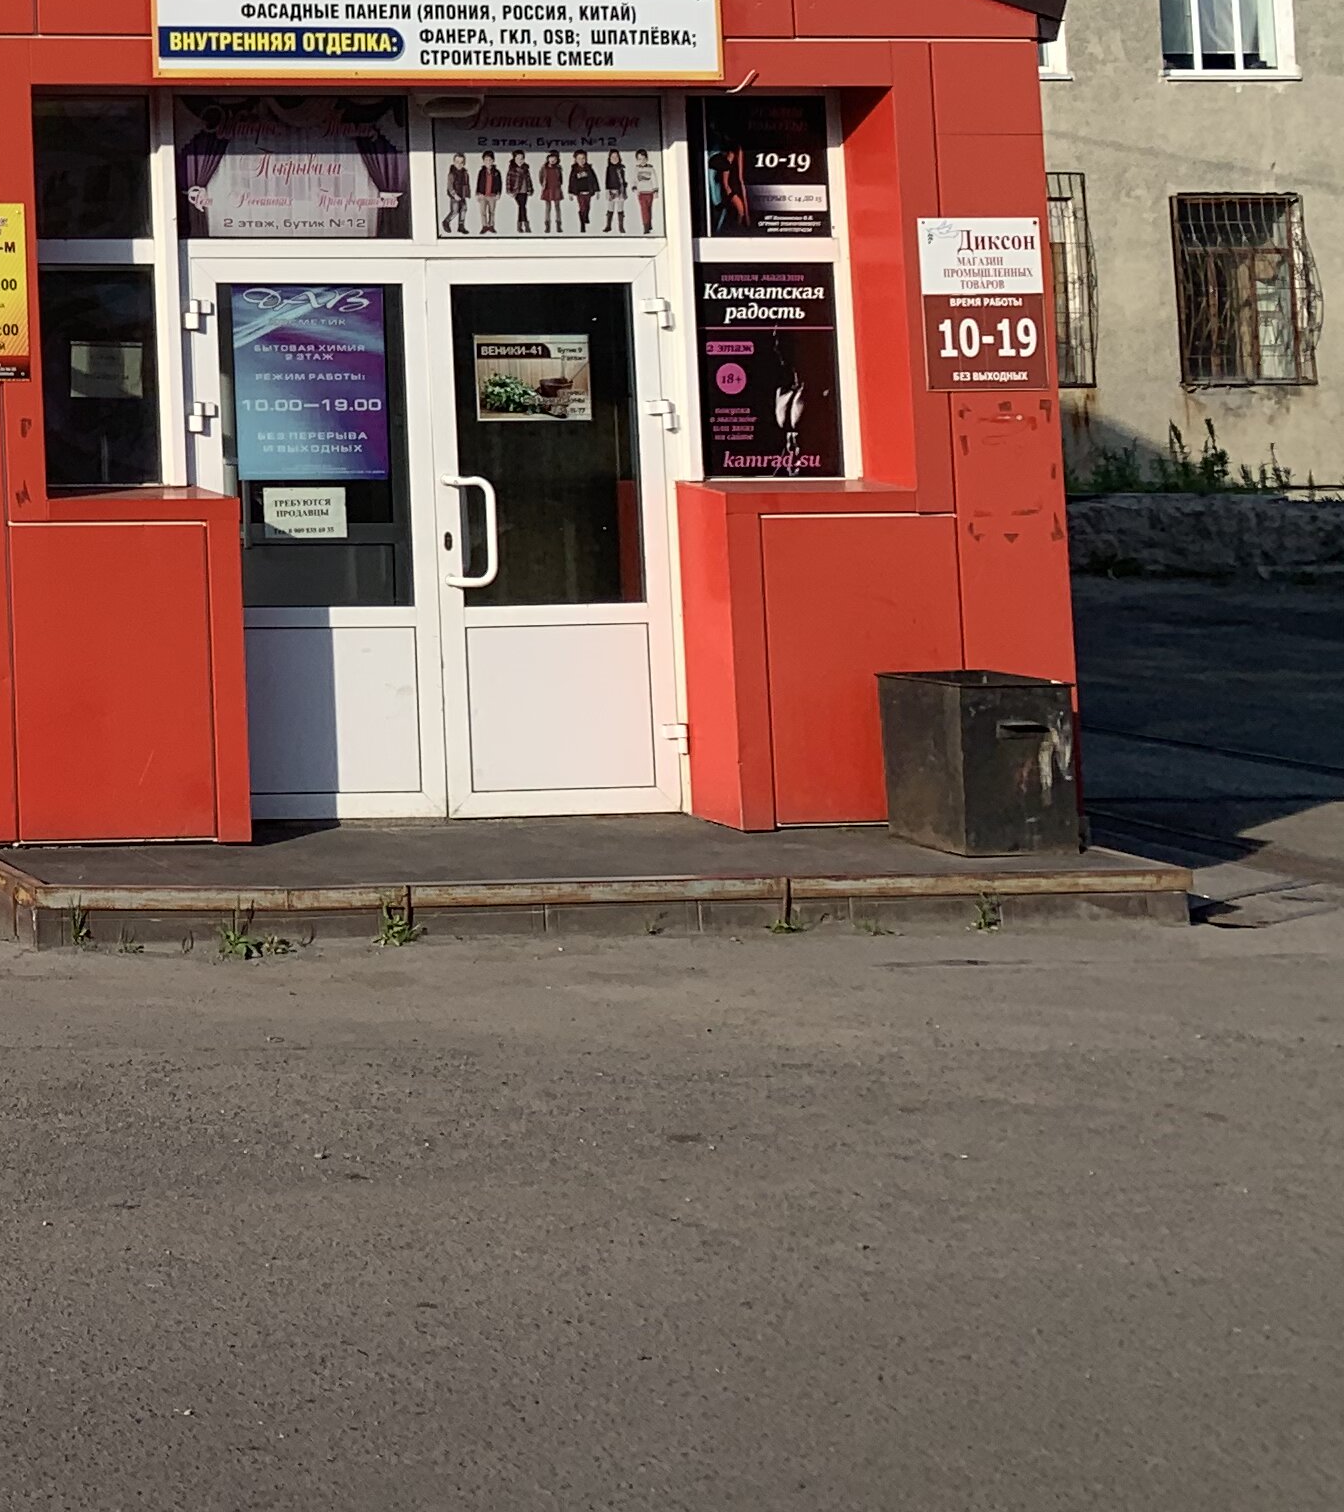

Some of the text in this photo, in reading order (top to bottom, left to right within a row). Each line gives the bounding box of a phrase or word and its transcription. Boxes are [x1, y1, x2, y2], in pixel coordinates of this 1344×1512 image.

[241, 2, 637, 23] ФАСАДНЫЕ ПАНЕЛИ (ЯПОНИЯ, РОССИЯ, КИТАЙ)
[419, 26, 697, 48] ФАНЕРА, ГКЛ, OSB; ШПАТЛЁВКА;
[169, 31, 398, 55] ВНУТРЕННЯЯ ОТДЕЛКА:
[420, 49, 614, 66] СТРОИТЕЛЬНЫЕ СМЕСИ
[478, 137, 488, 146] 2
[491, 137, 532, 148] этаж,
[754, 152, 811, 172] 10-19
[223, 218, 233, 228] 2
[238, 219, 279, 230] этаж,
[956, 229, 1035, 254] Диксон
[957, 257, 1004, 267] МАГАЗИН
[943, 267, 1033, 278] ПРОМЫШЛЕННЫХ
[960, 279, 1005, 290] ТОВАРОВ
[703, 282, 825, 300] Камчатская
[949, 297, 1023, 307] ВРЕМЯ РАБОТЫ
[723, 302, 806, 324] радость
[938, 317, 1038, 358] 10-19
[254, 344, 365, 352] БЫТОВАЯ ХИМИЯ
[480, 345, 542, 356] ВЕНИКИ-41
[716, 344, 752, 353] этаж
[296, 353, 334, 361] ЭТАЖ
[255, 373, 305, 381] РЕЖИМ
[720, 373, 743, 385] 18+
[952, 371, 1029, 382] БЕЗ ВЫХОДНЫХ
[257, 431, 368, 440] БЕЗ ПЕРЕРЫВА
[262, 444, 363, 454] И ВЫХОДНЫХ
[723, 450, 821, 468] kamrad.su
[273, 498, 331, 507] ТРЕБУЮТСЯ
[276, 508, 329, 518] ПРОДАВЦЫ
